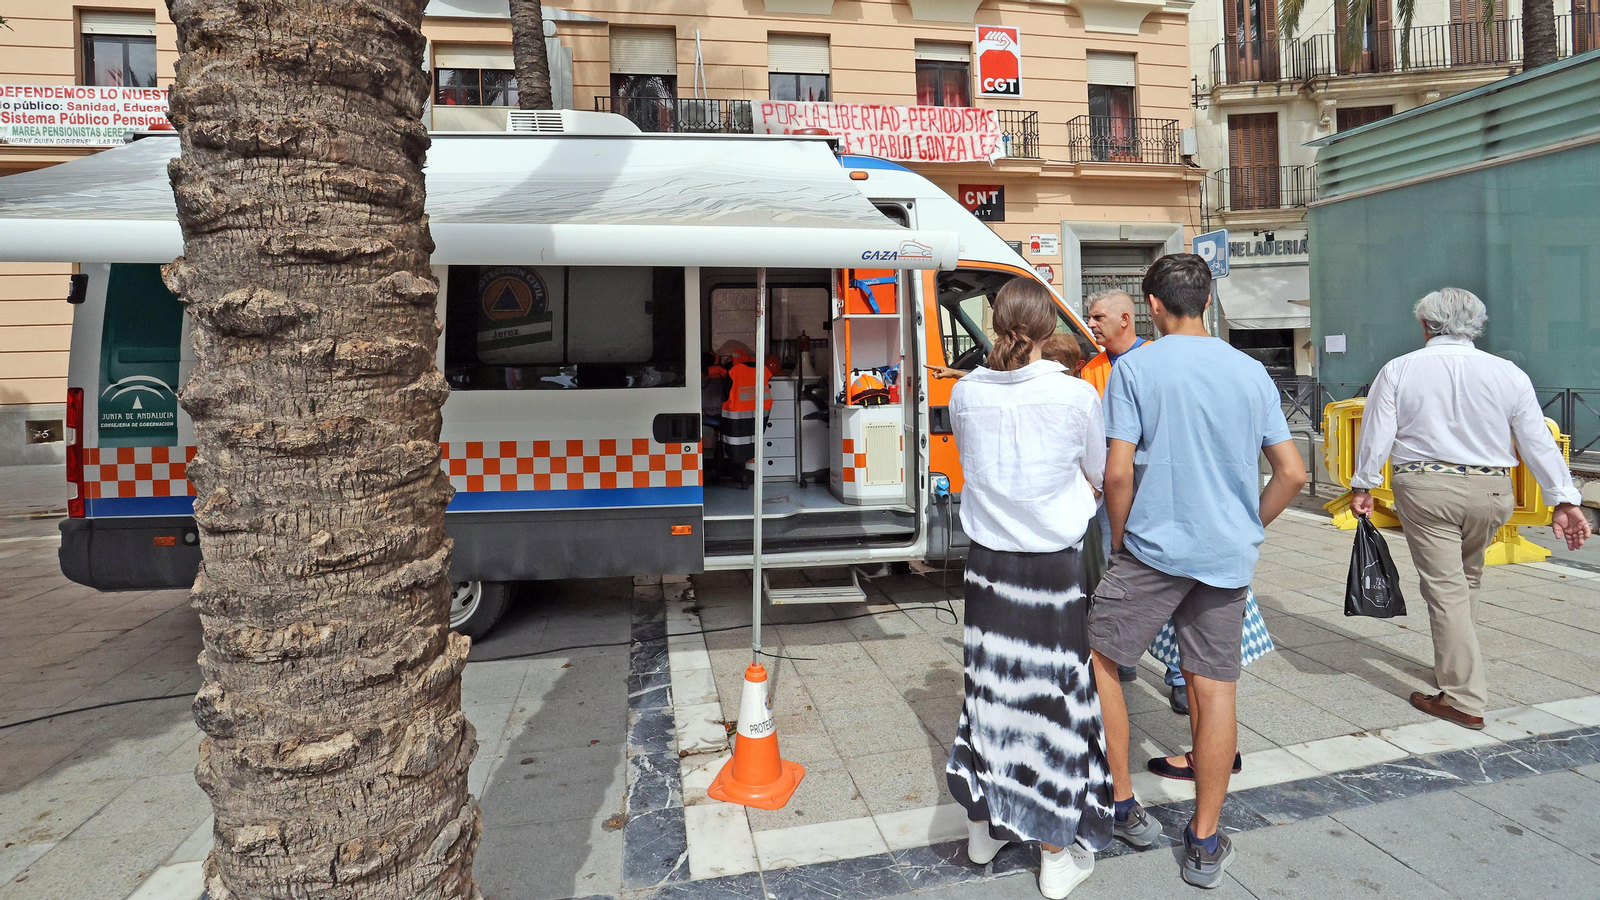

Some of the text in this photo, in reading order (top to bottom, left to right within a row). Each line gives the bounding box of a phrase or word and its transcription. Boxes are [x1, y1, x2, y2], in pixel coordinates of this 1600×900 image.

[983, 77, 1017, 92] CGT
[0, 86, 95, 99] DEFENDEMOS
[100, 88, 118, 99] LO
[14, 101, 63, 111] público:
[67, 102, 120, 113] Sanidad,
[1, 111, 56, 124] Sistema
[60, 112, 110, 126] Público
[12, 126, 41, 136] MAREA
[43, 126, 101, 138] PENSIONISTAS
[870, 134, 912, 159] PABLO
[965, 191, 998, 205] CNT
[1198, 240, 1217, 262] P
[1229, 239, 1309, 257] HELADERIA
[861, 250, 898, 261] GAZA
[491, 328, 520, 340] Jerez
